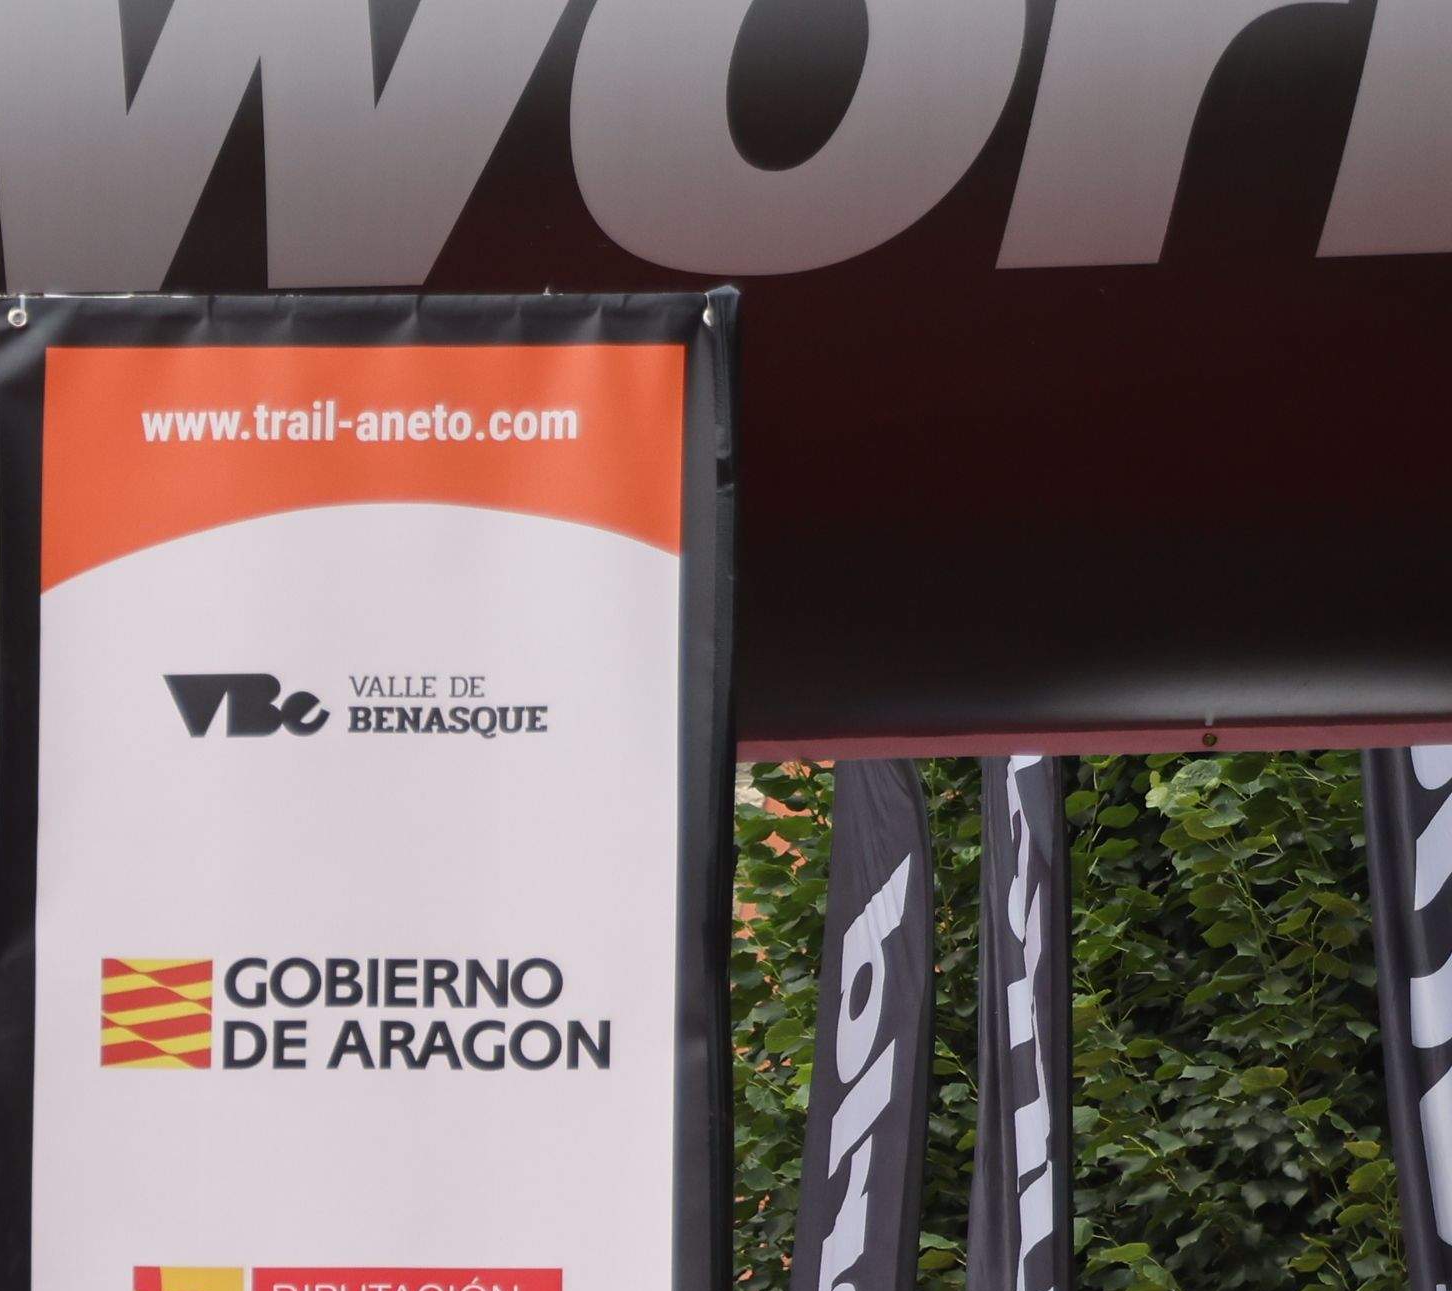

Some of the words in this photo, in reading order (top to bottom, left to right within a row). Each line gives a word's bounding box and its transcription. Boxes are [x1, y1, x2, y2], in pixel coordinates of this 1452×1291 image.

[143, 400, 578, 442] www.trail-aneto.com
[349, 676, 437, 698] VALLE
[449, 676, 485, 698] DE
[348, 706, 548, 739] BENASQUE
[224, 957, 564, 1008] GOBIERNO
[222, 1020, 307, 1070] DE
[326, 1019, 611, 1070] ARAGON
